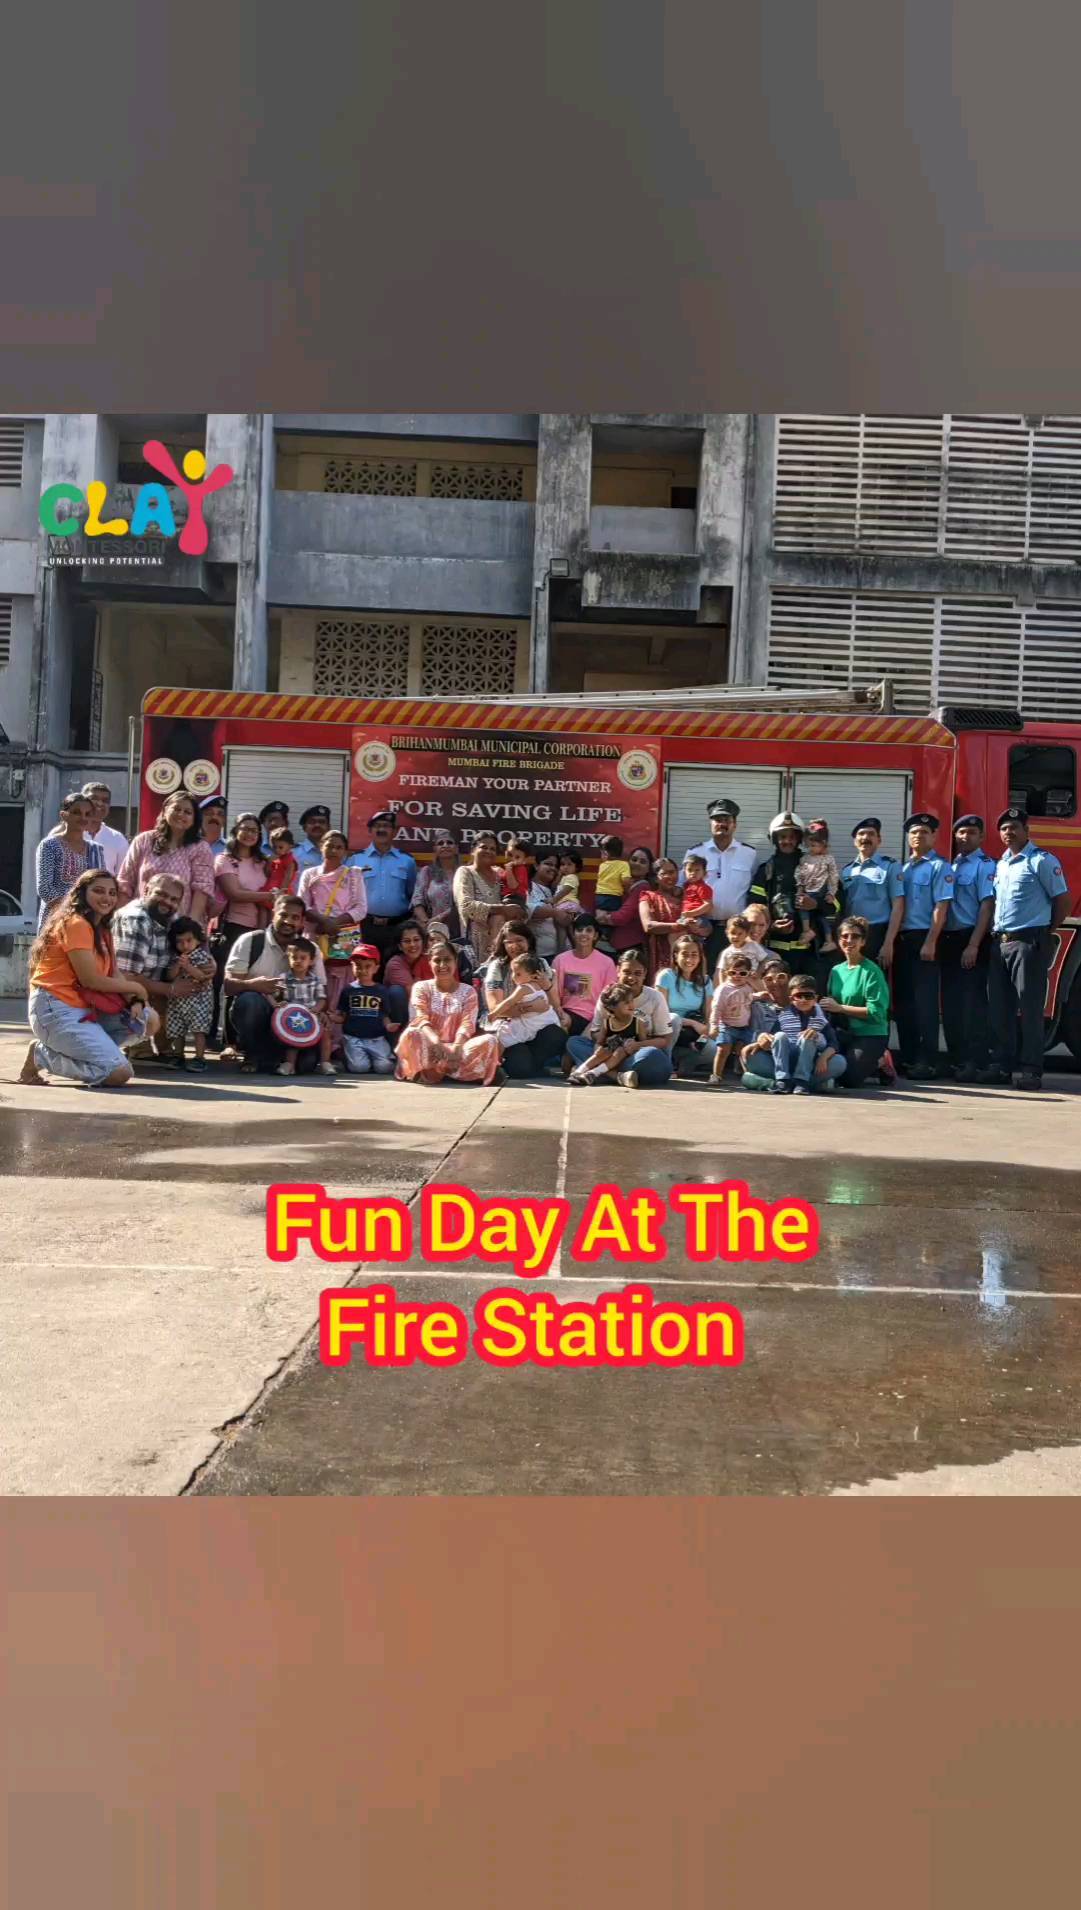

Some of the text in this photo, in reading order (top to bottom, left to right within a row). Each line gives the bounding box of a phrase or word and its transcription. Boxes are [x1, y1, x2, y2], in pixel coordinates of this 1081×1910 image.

[391, 736, 478, 752] BRIHANMUMBAI
[481, 739, 541, 754] MUNICIPAL
[543, 742, 622, 758] CORPORATION
[447, 757, 565, 770] MUMBAI FIRE BRIGADE
[398, 774, 479, 789] FIREMAN
[482, 777, 529, 790] YOUR
[534, 779, 612, 793] PARTNER
[387, 799, 622, 823] FOR SAVING LIFE
[461, 828, 605, 848] POPERTY
